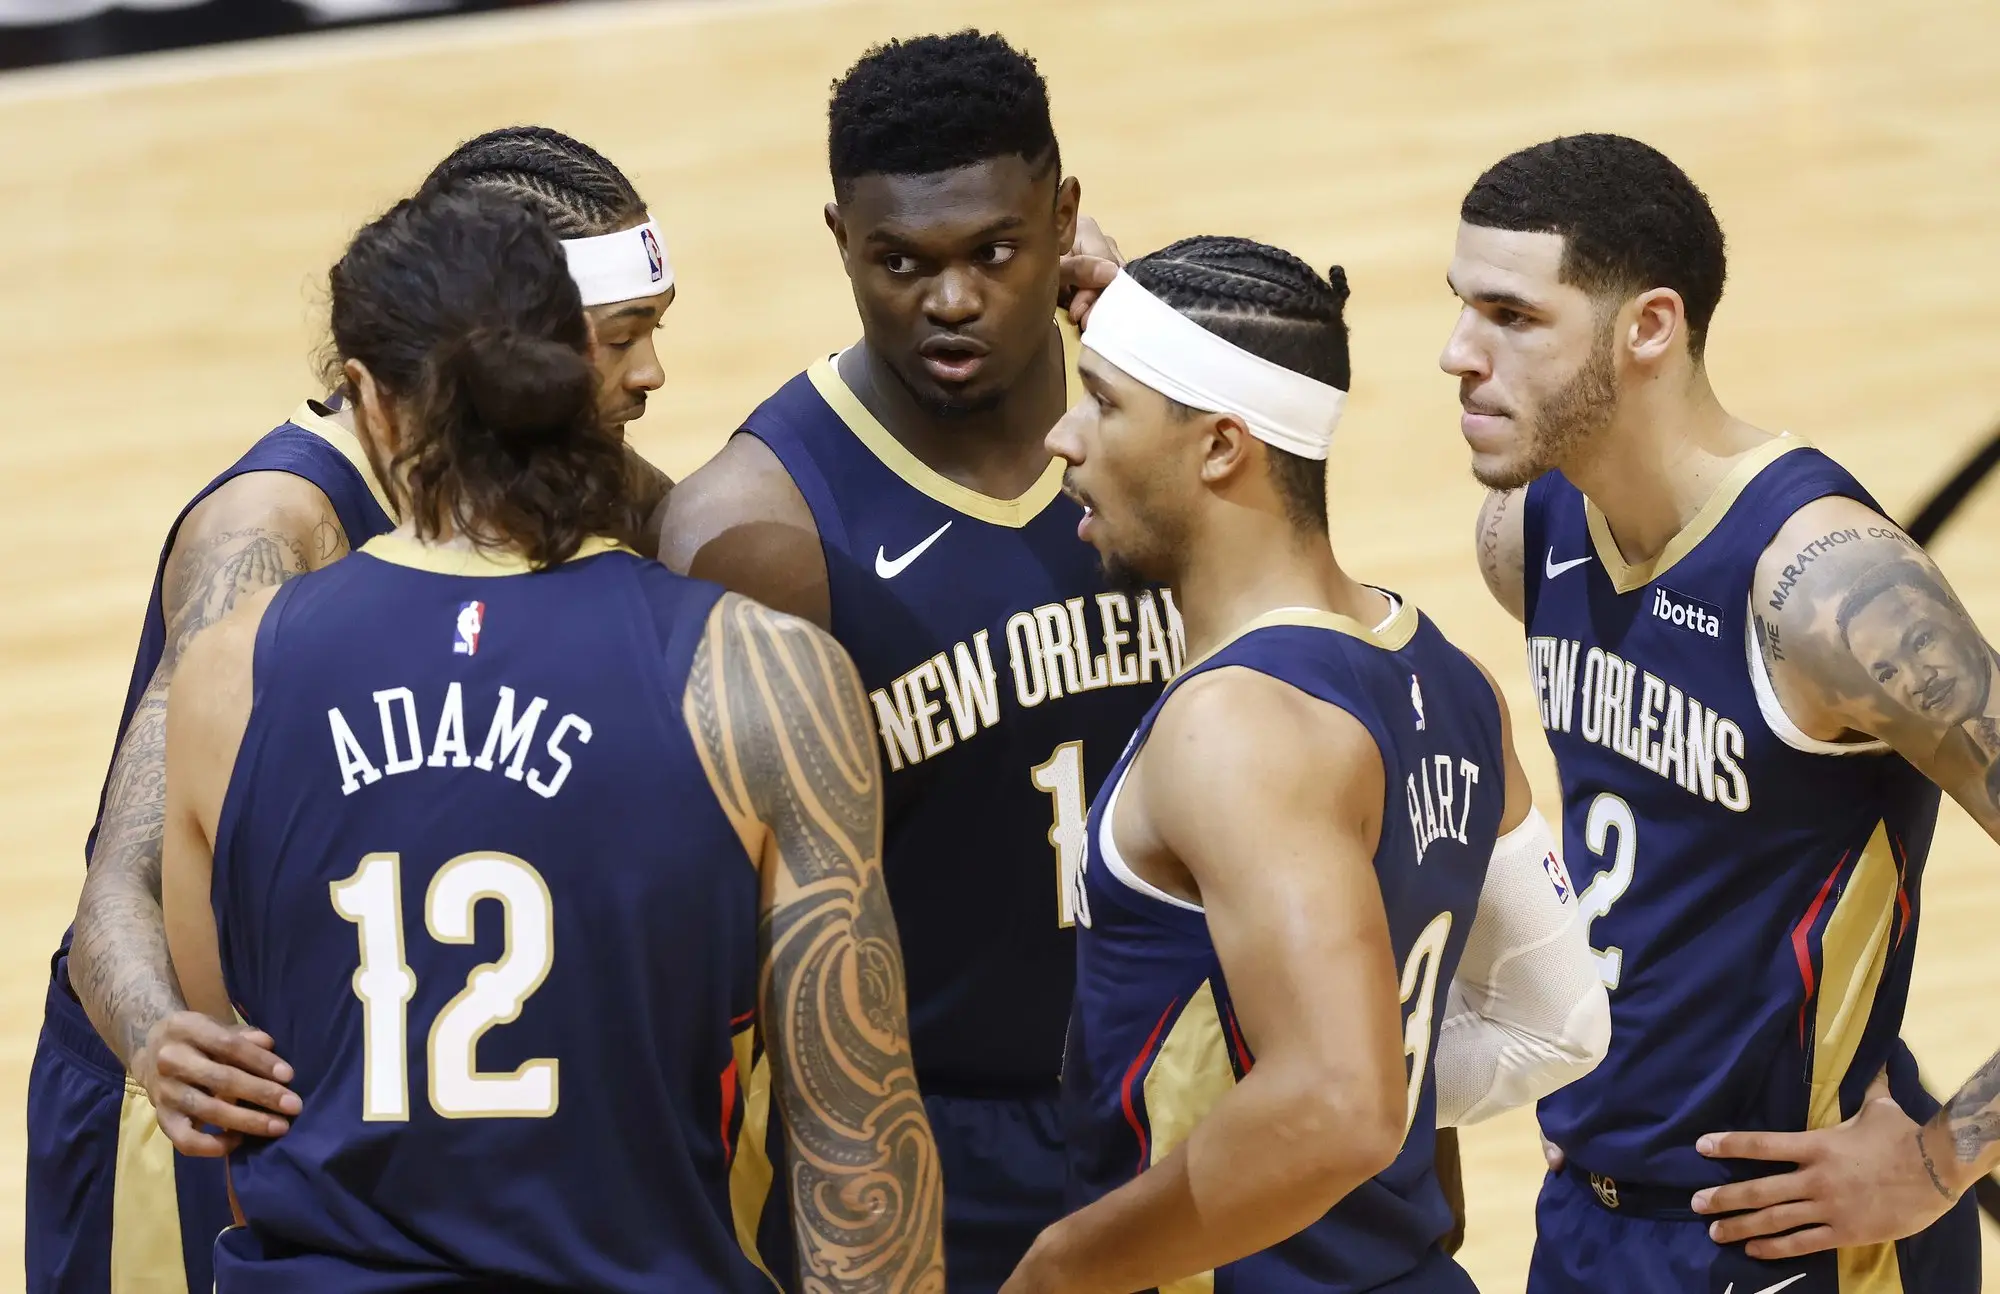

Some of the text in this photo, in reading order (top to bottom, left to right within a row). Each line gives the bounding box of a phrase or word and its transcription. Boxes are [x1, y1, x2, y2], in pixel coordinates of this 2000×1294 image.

[1652, 587, 1720, 638] ibotta
[1769, 528, 1862, 611] MARATHON
[870, 628, 1001, 773] NEW
[1766, 621, 1786, 662] THE
[328, 681, 593, 799] ADAMS
[1582, 646, 1751, 813] ORLEANS
[1030, 740, 1088, 929] 1
[1406, 754, 1480, 866] HART
[1577, 791, 1637, 990] 2
[329, 851, 560, 1122] 12
